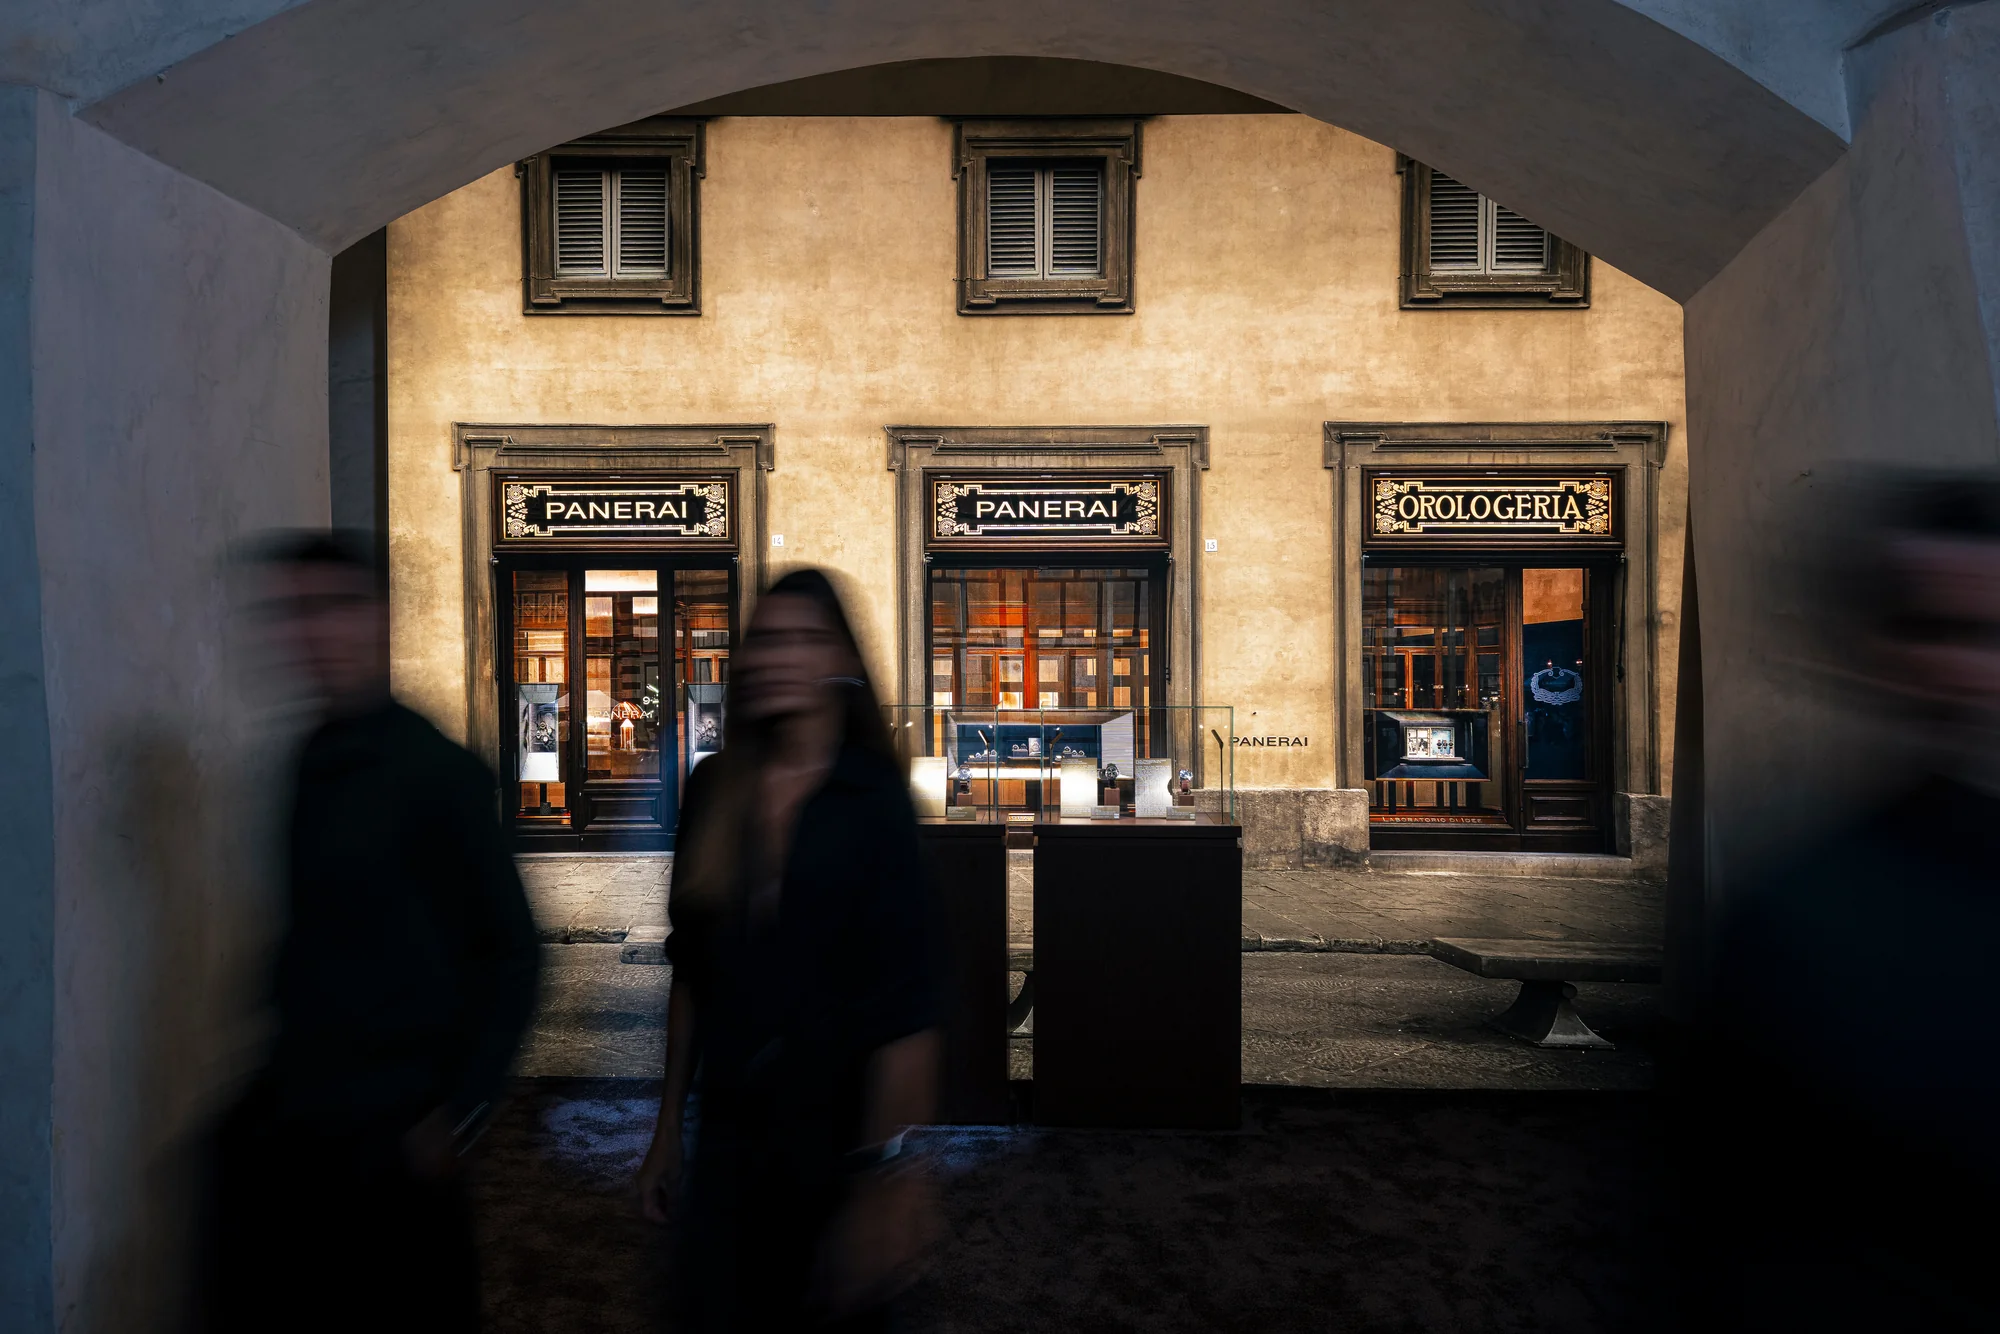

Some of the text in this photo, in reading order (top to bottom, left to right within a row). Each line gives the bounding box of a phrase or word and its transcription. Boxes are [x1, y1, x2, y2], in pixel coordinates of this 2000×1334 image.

[546, 501, 687, 519] PANERAI
[976, 500, 1117, 518] PANERAI
[1399, 494, 1584, 520] OROLOGERIA
[595, 710, 654, 720] PANERAI
[1229, 736, 1308, 747] PANERAI
